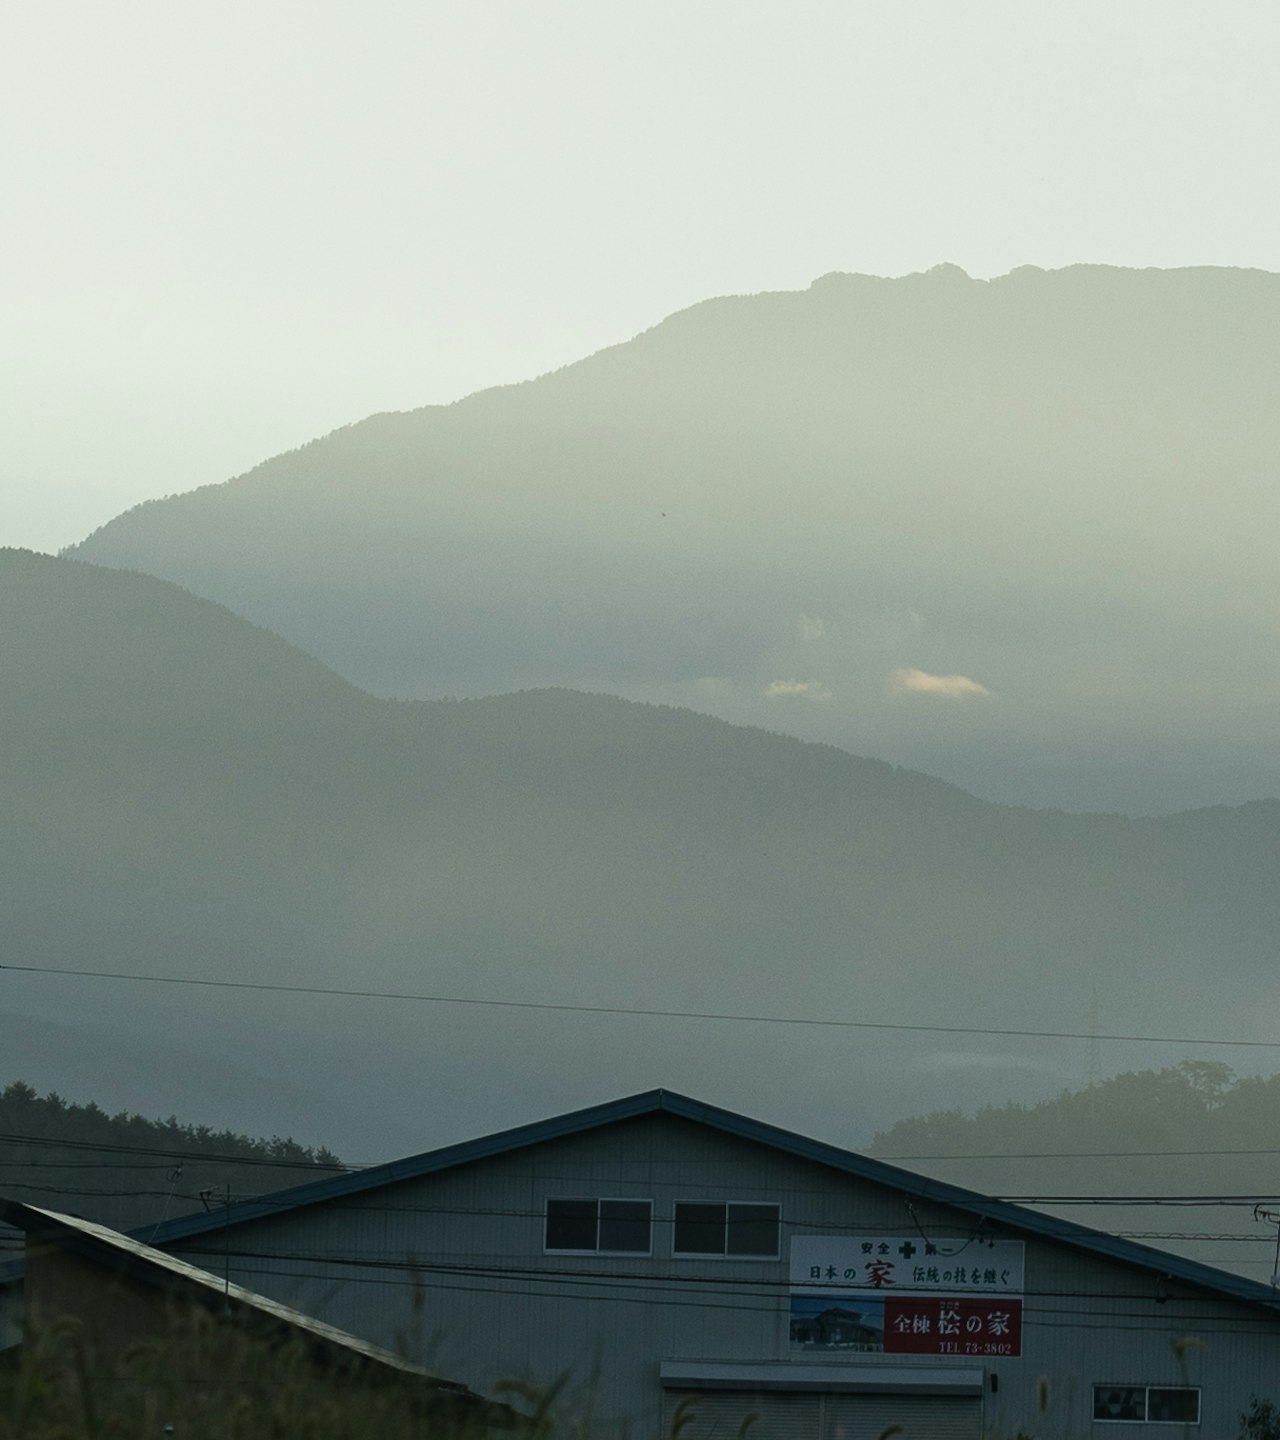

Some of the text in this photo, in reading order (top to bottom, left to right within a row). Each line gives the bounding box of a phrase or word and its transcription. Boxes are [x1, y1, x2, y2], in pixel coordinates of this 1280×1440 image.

[861, 1242, 953, 1256] 安全 第一
[809, 1259, 1010, 1288] 日本の家 伝統の技を継ぐ
[938, 1342, 1012, 1355] TEL 73-3802
